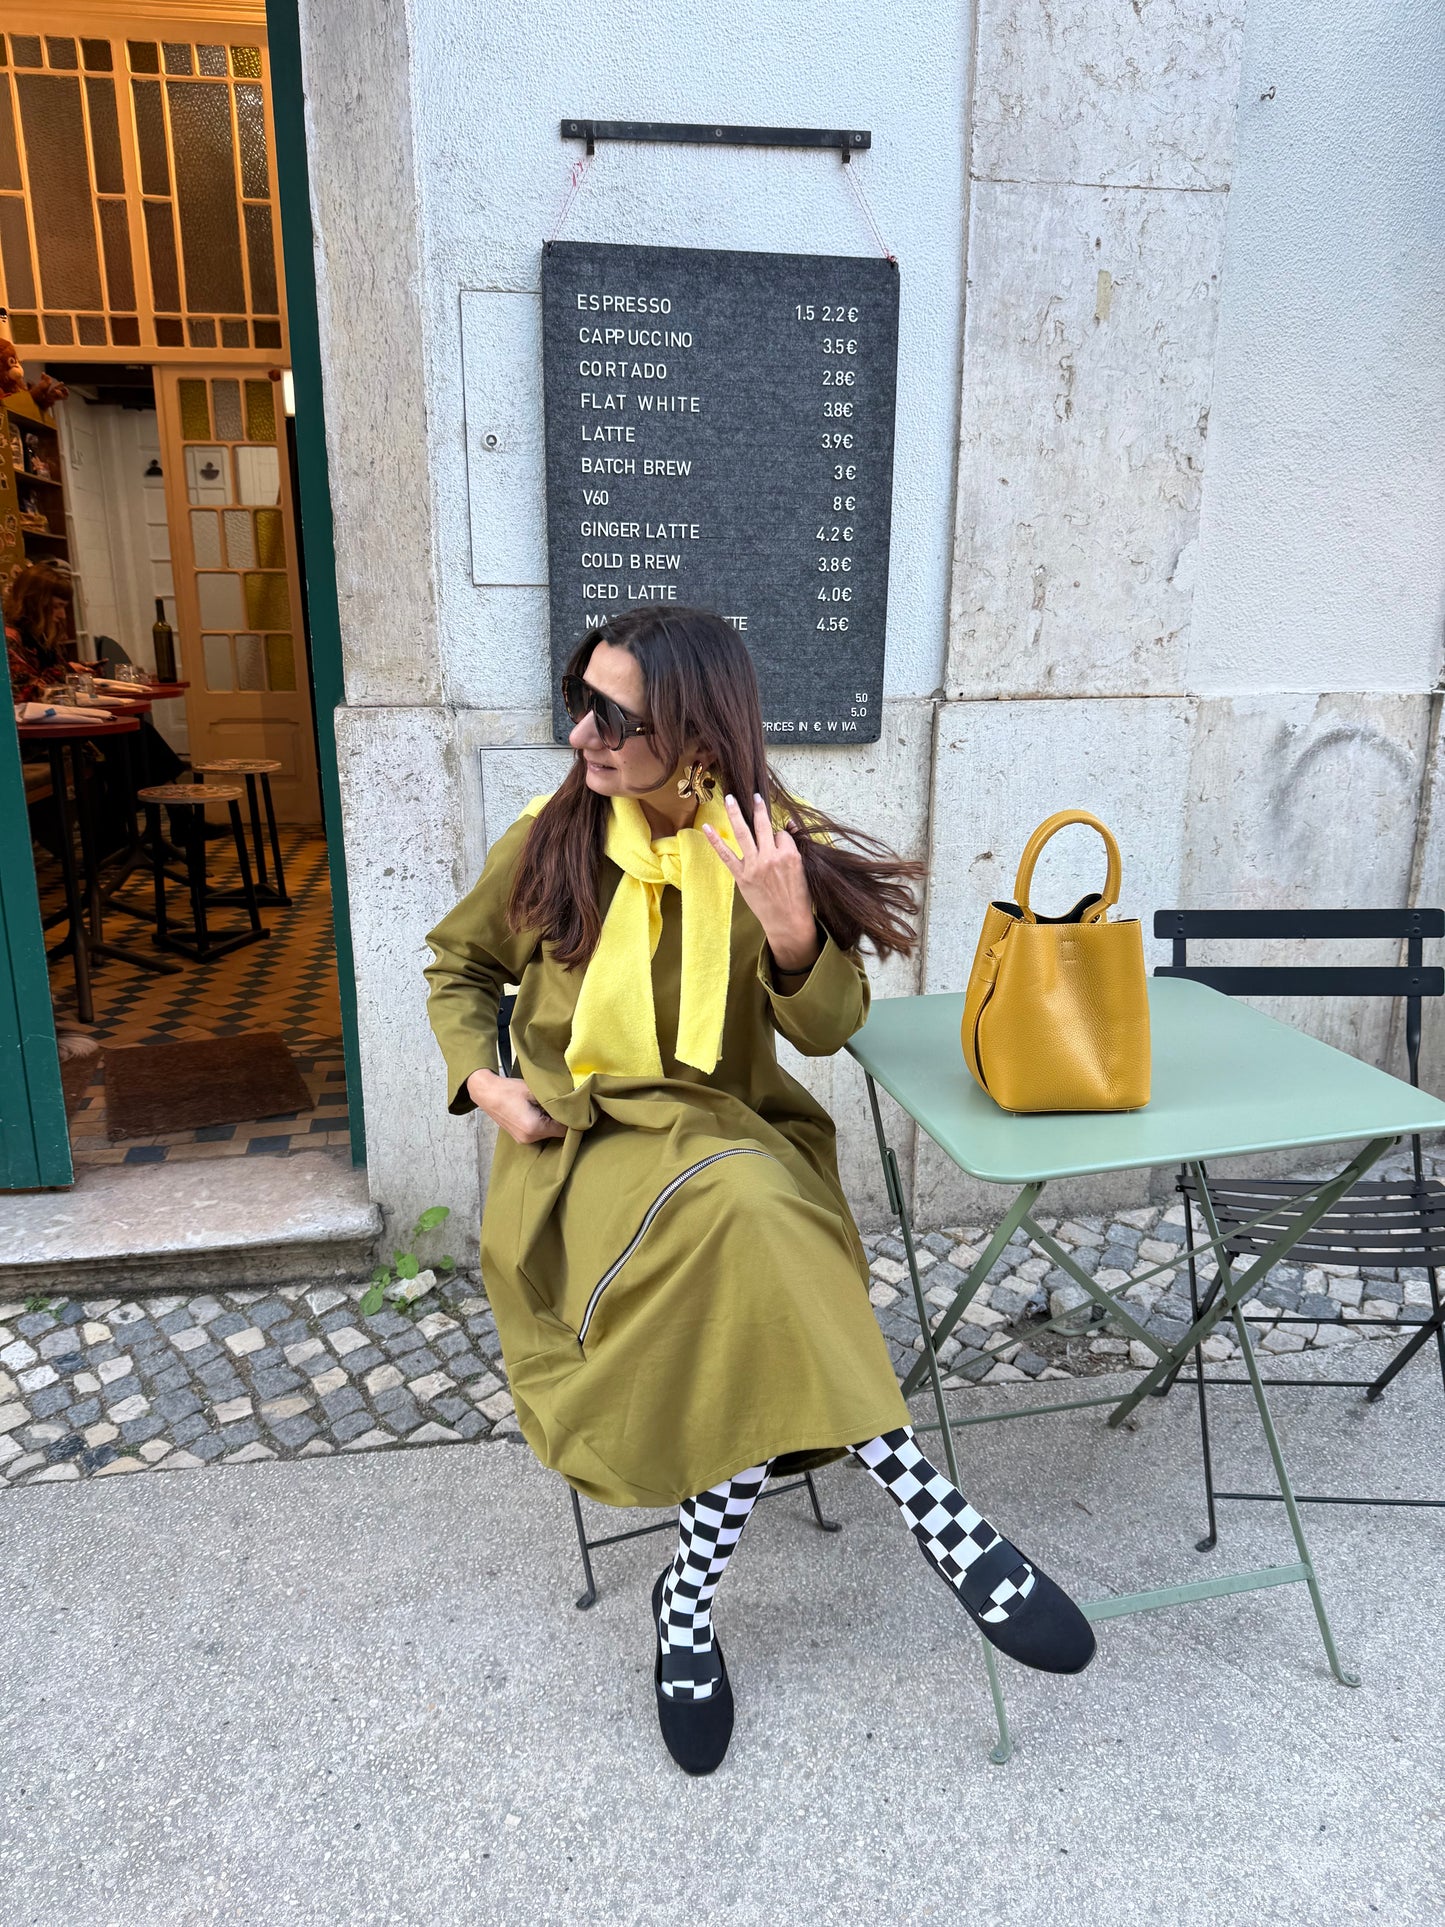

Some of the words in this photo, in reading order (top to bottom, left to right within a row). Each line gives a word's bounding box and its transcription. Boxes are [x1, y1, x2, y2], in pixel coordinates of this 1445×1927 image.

[577, 293, 672, 315] ESPRESSO
[795, 304, 816, 322] 1.5
[579, 327, 693, 349] CAPPUCCINO
[822, 337, 858, 355] 3.5€
[579, 360, 668, 380] CORTADO
[822, 369, 856, 387] 2.8€
[580, 392, 627, 411] FLAT
[637, 394, 701, 413] WHITE
[823, 401, 854, 418] 3.8€
[581, 424, 636, 443] LATTE
[821, 433, 854, 450] 3.9€
[580, 457, 636, 475] BATCH
[643, 459, 692, 477] BREW
[582, 489, 609, 506] V60
[580, 521, 640, 538] GINGER
[645, 522, 701, 539] LATTE
[581, 552, 623, 569] COLD
[630, 553, 681, 570] BREW
[817, 556, 852, 572] 3.8€
[582, 583, 619, 599] ICED
[627, 584, 678, 600] LATTE
[817, 586, 853, 603] 4.0€
[816, 616, 849, 632] 4.5€
[850, 707, 867, 718] 5.0
[798, 721, 809, 732] IN
[813, 721, 822, 732] €
[826, 721, 838, 732] W
[841, 721, 857, 732] IVA
